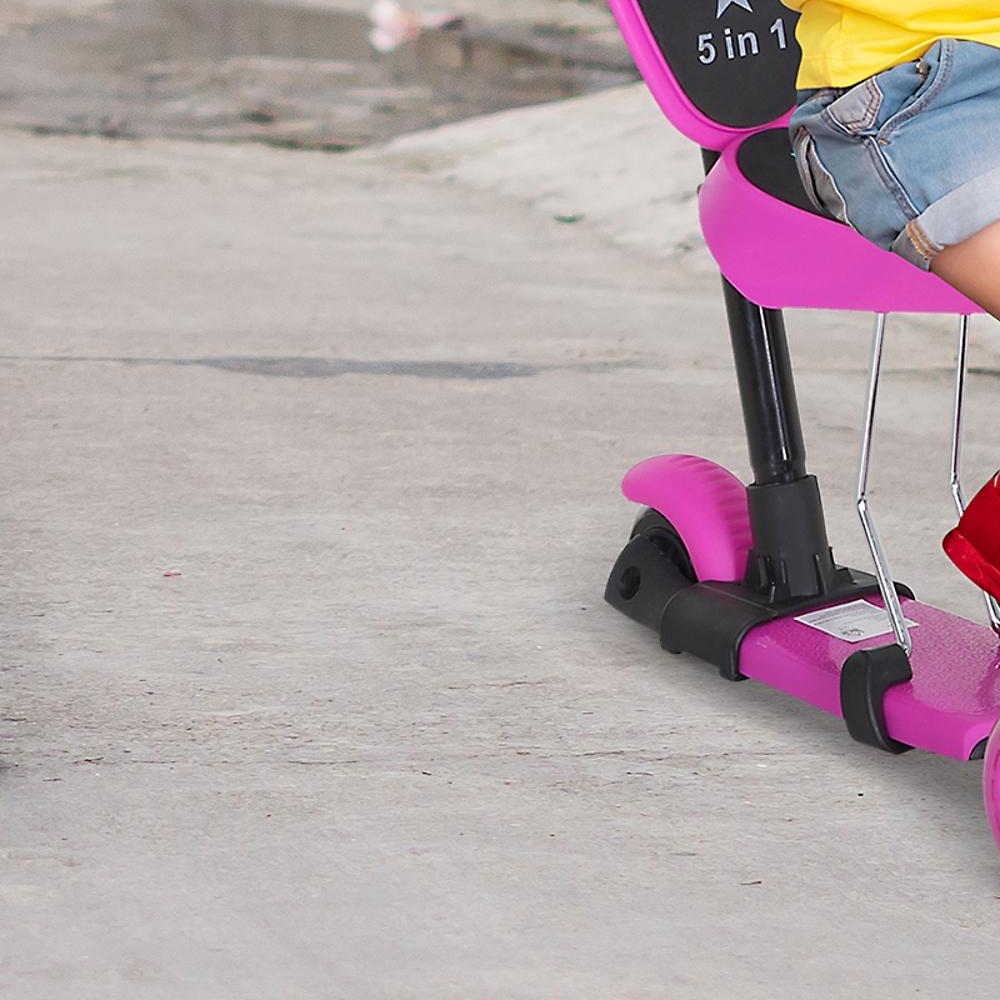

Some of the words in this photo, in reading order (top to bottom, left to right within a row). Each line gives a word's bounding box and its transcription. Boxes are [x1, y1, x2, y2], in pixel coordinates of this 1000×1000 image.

[698, 33, 716, 65] 5
[724, 28, 760, 60] in
[770, 18, 787, 49] 1
